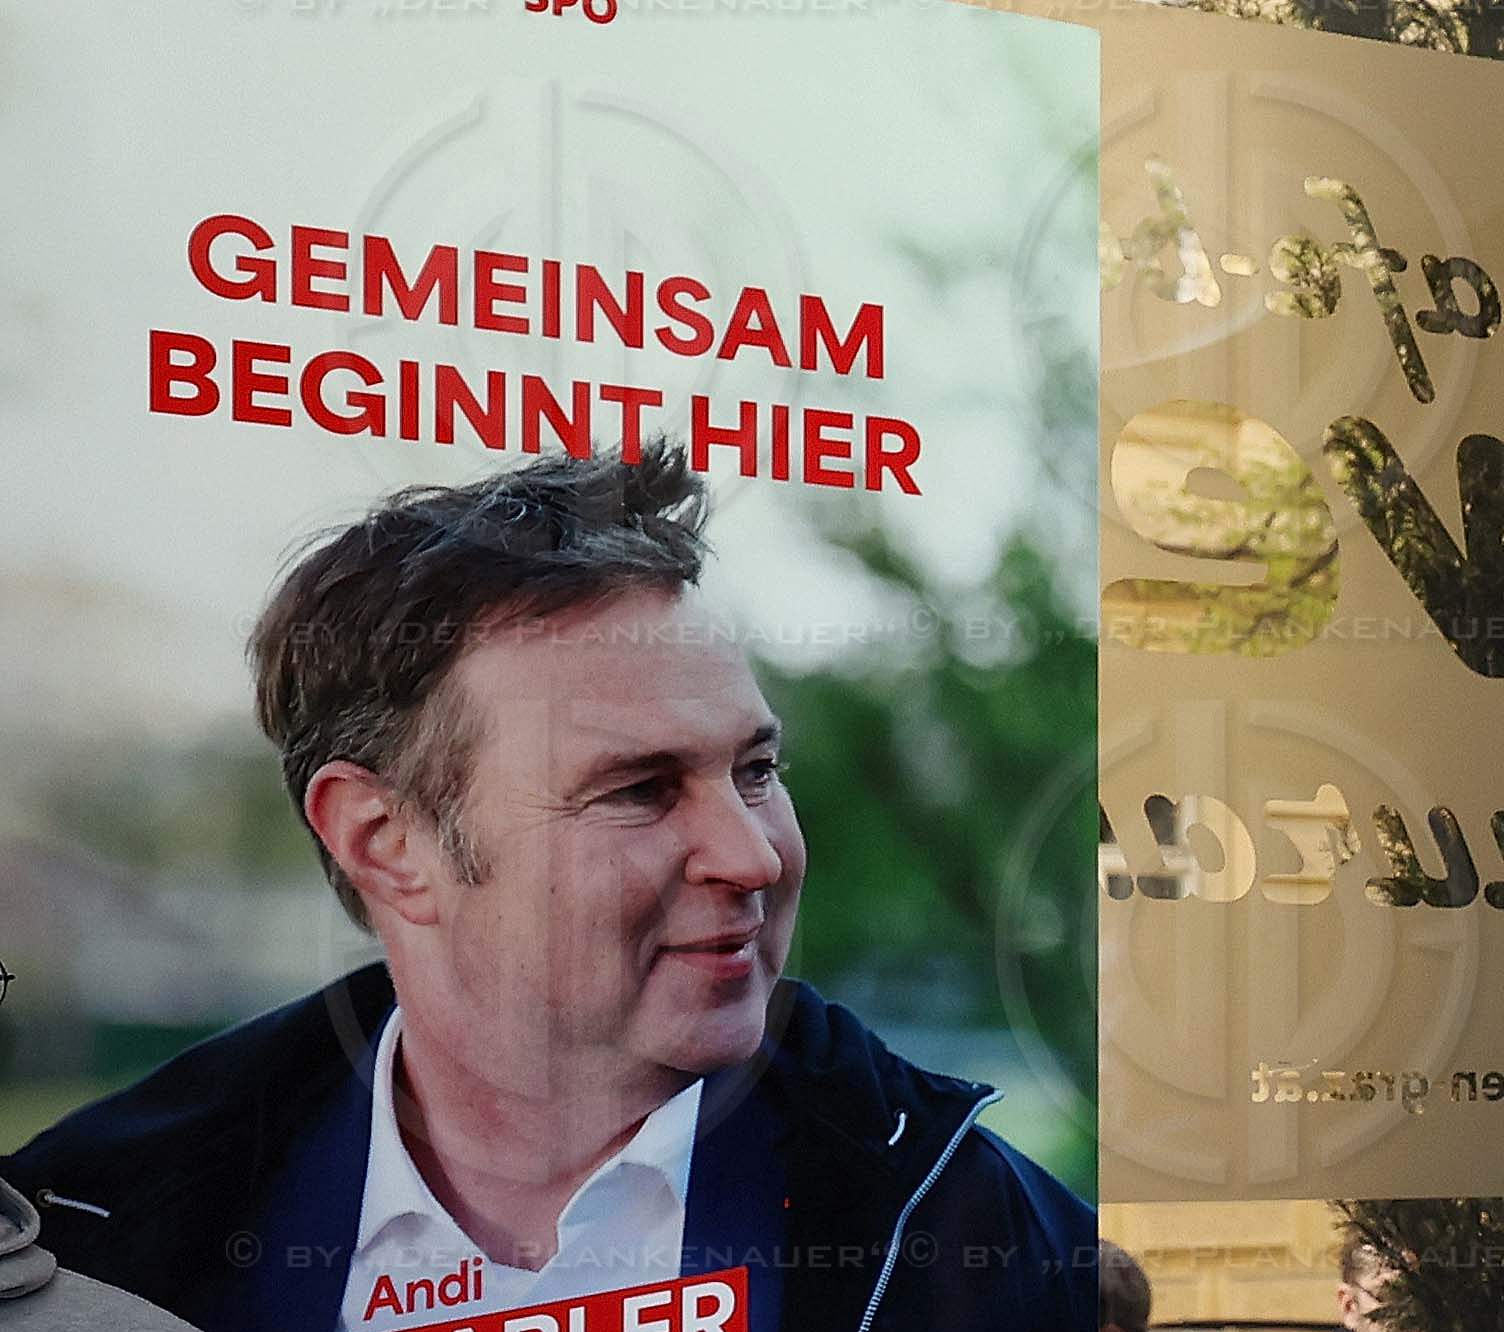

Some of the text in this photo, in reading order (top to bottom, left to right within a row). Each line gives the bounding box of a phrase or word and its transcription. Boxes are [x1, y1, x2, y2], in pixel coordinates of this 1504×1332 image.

[187, 213, 887, 380] GEMEINSAM
[147, 329, 924, 497] BEGINNT HIER
[363, 1255, 484, 1320] Andi
